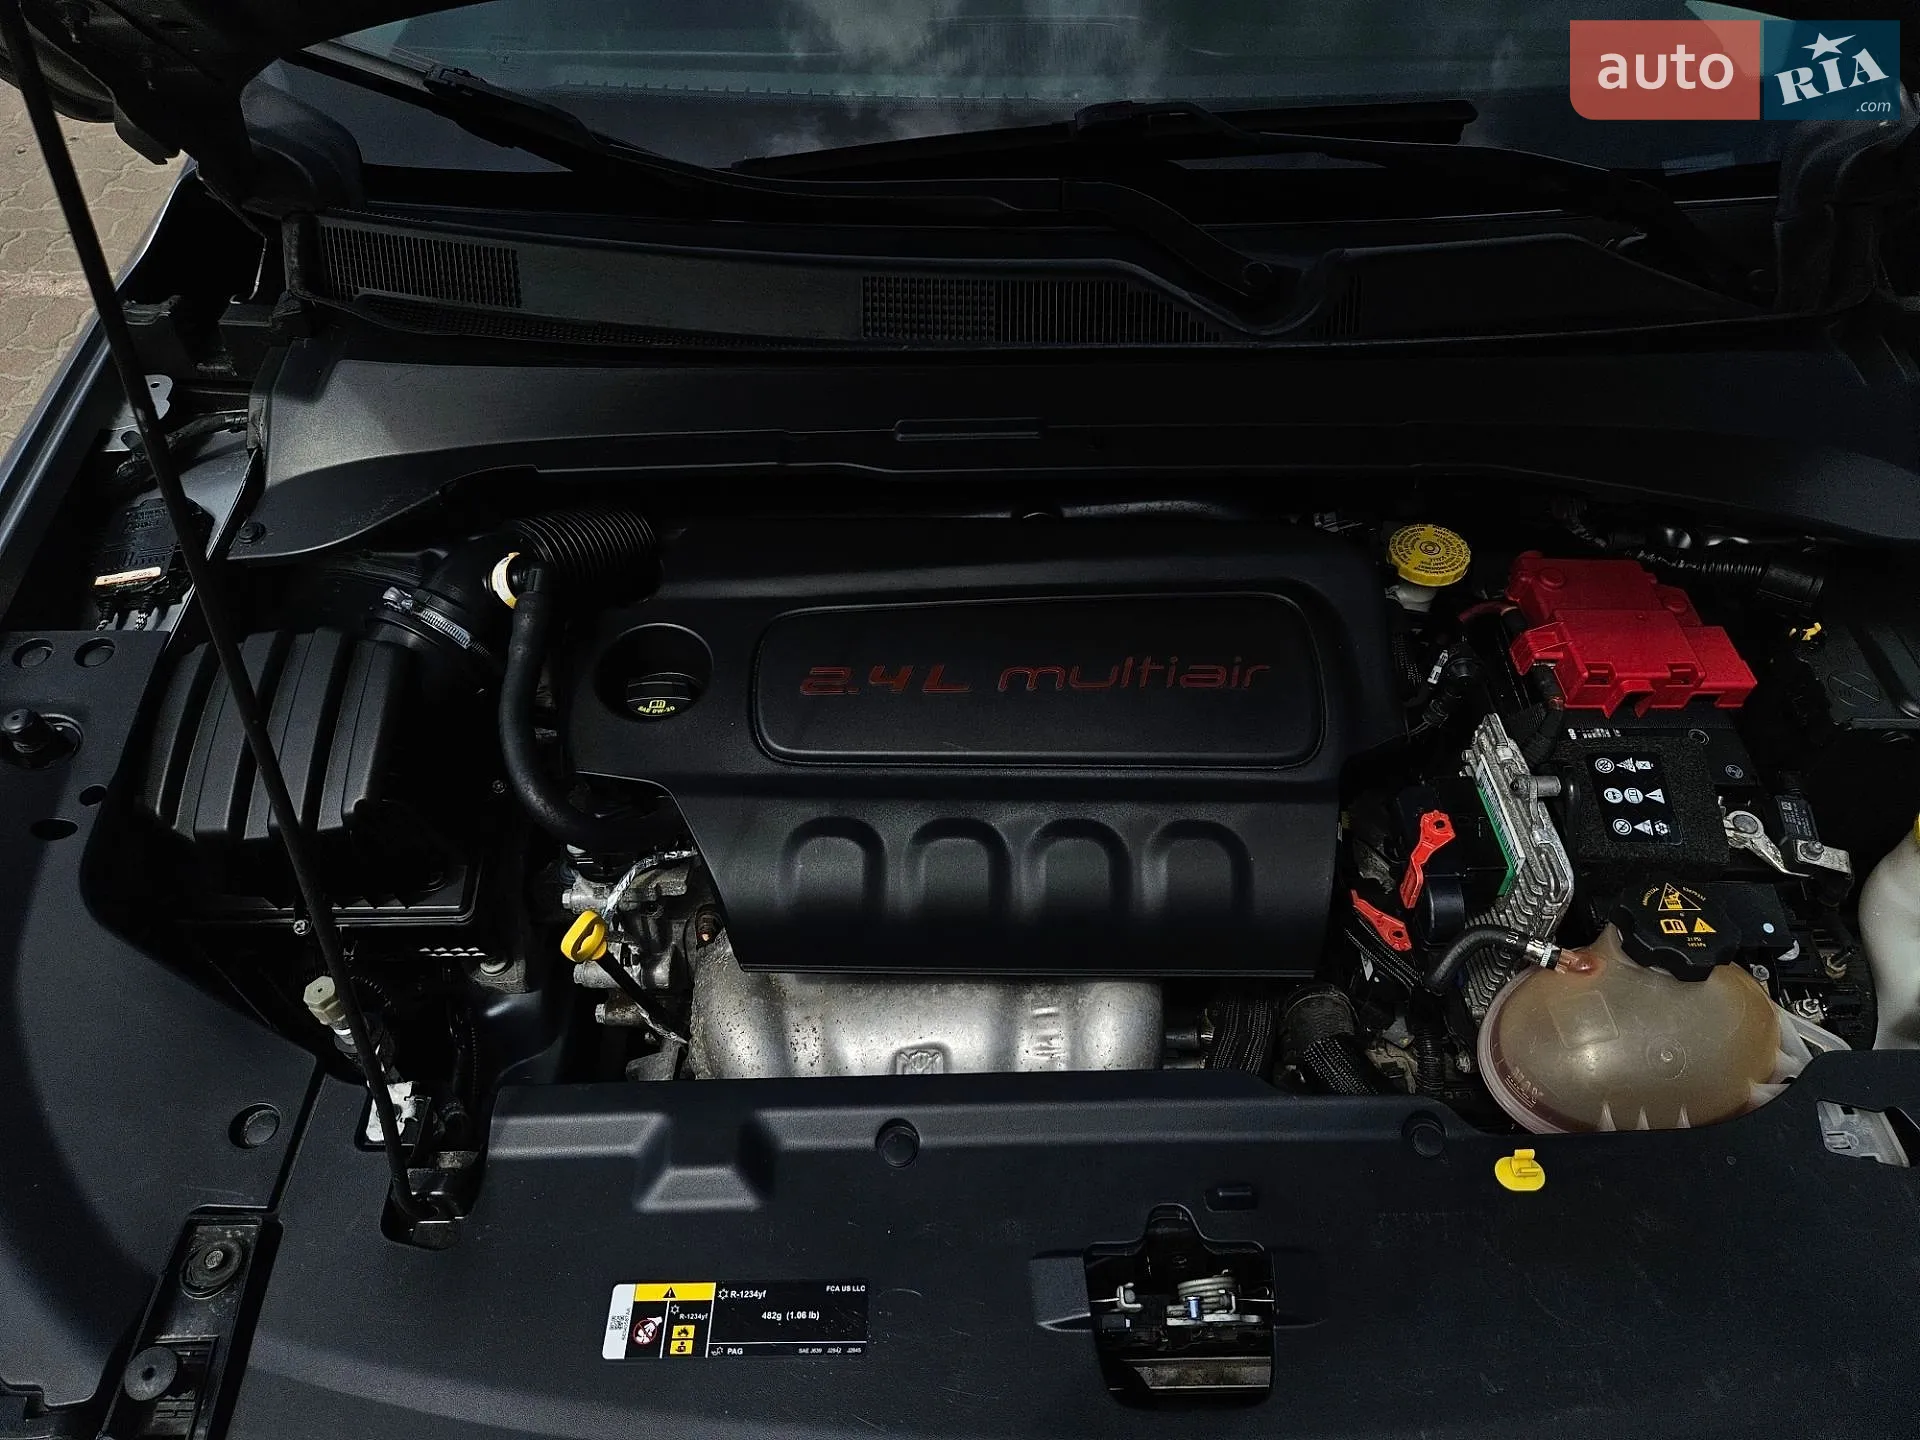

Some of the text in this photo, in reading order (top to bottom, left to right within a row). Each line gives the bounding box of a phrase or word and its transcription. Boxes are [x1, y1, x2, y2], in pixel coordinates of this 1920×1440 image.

[996, 656, 1272, 693] multiair
[729, 1289, 766, 1300] R-1234yf
[679, 1313, 708, 1321] R-1234yf
[761, 1311, 820, 1321] 482g (1.06 lb)
[727, 1347, 743, 1355] PAG
